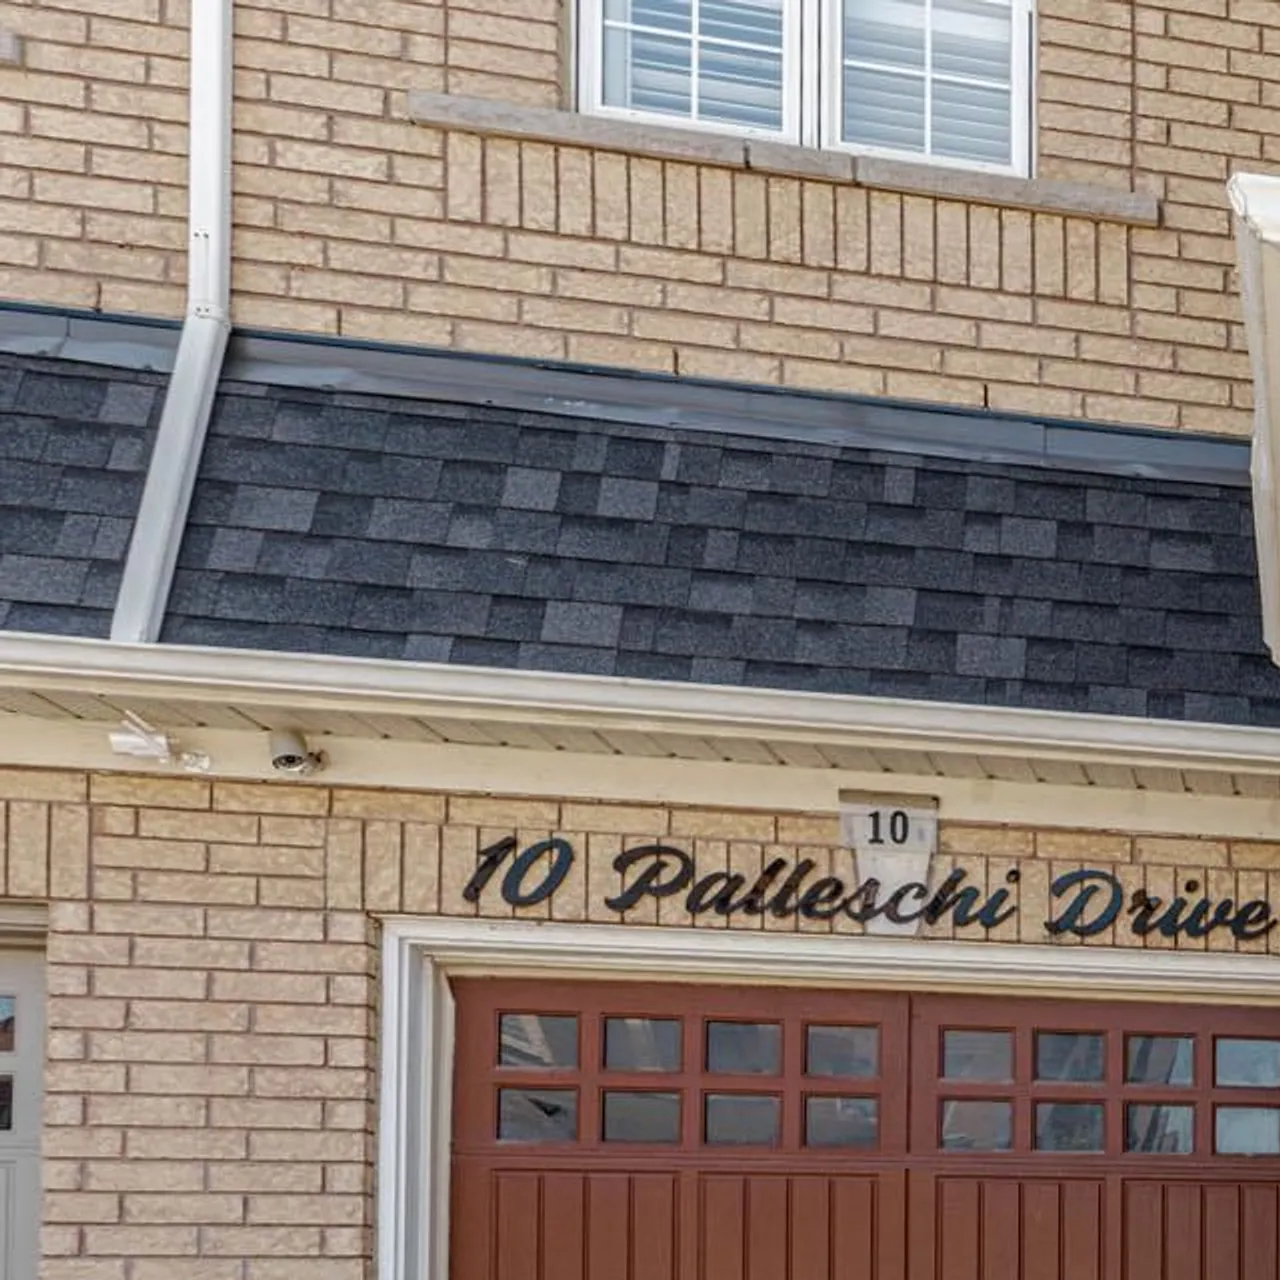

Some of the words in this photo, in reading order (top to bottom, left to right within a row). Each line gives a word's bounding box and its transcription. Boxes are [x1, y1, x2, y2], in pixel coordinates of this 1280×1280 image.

[866, 810, 911, 845] 10
[462, 836, 576, 907] 10
[604, 844, 1022, 929] Palleschi
[1043, 869, 1279, 940] Drive
